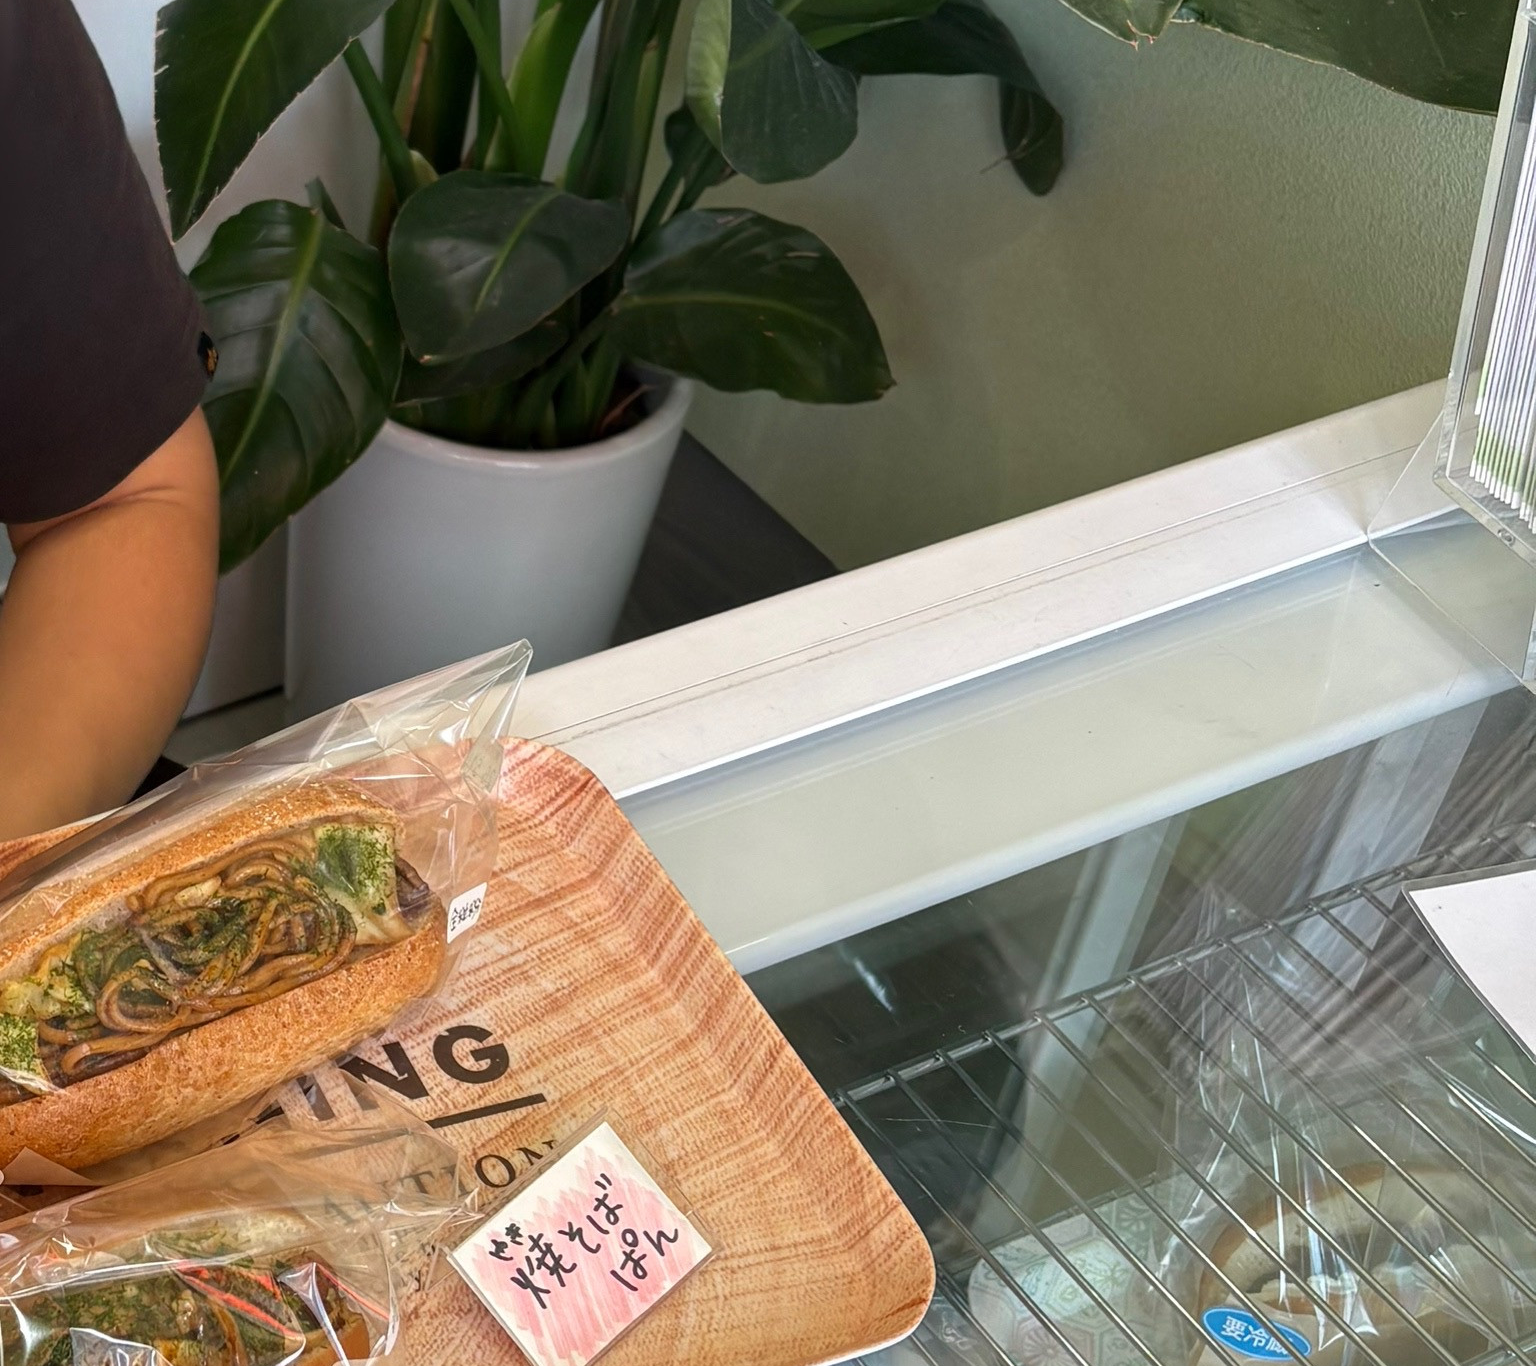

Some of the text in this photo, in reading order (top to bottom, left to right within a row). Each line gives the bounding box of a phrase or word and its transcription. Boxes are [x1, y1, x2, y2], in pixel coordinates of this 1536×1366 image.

[510, 1172, 624, 1310] 焼そば
[610, 1227, 680, 1292] ぱん
